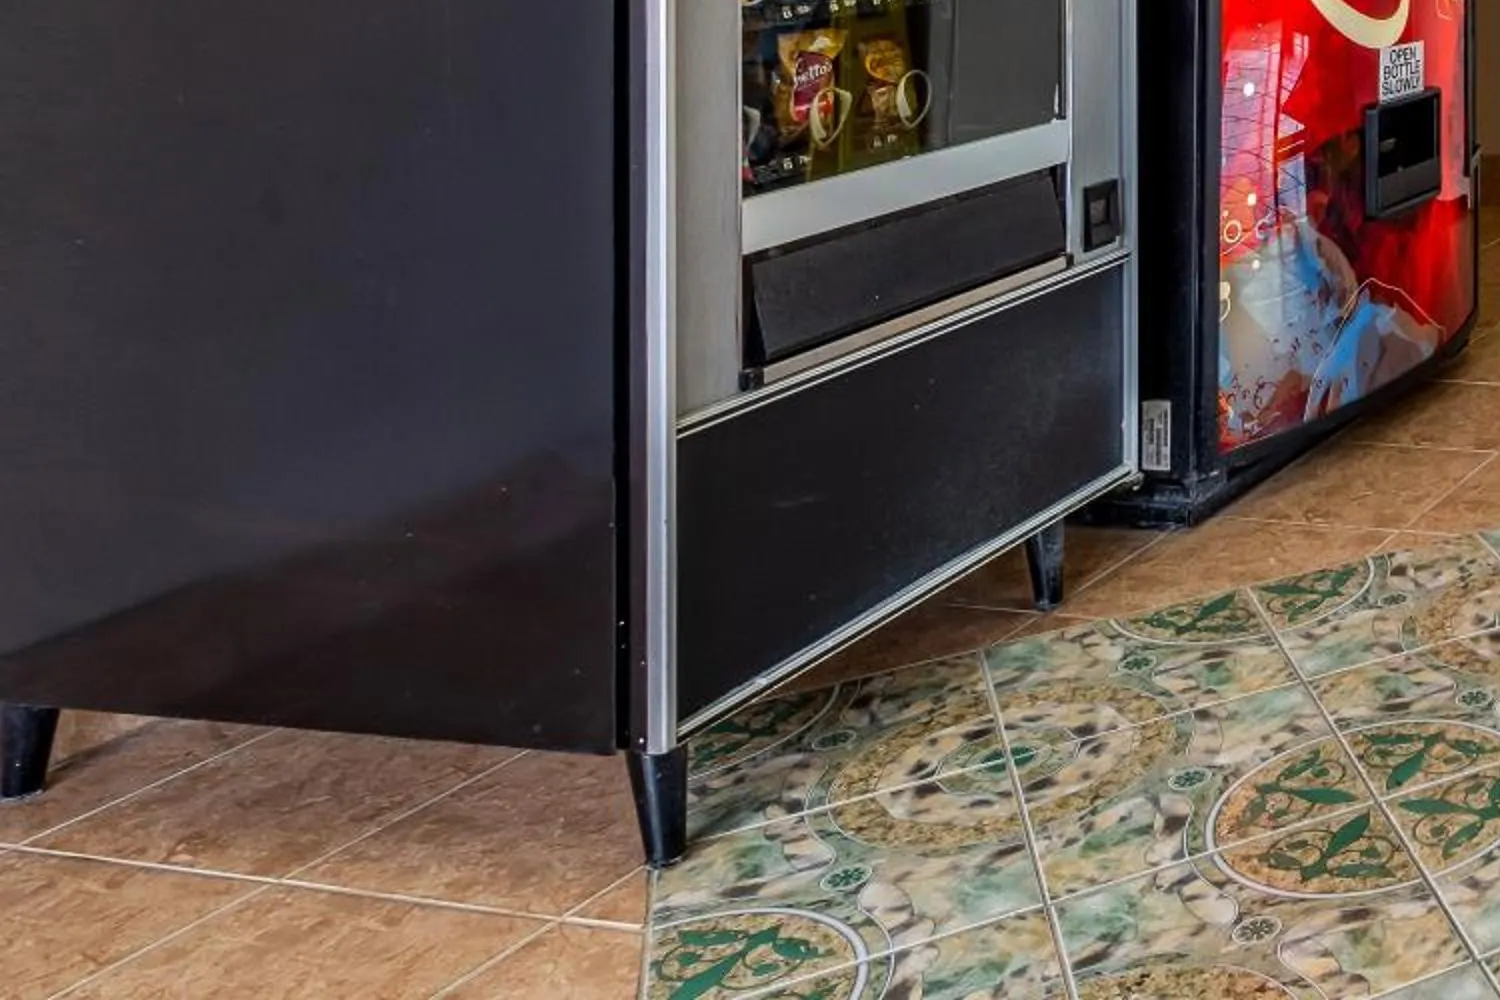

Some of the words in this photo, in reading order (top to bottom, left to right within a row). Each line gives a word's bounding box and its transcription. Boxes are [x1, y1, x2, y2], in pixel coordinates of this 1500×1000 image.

[1390, 46, 1417, 64] OPEN
[1383, 60, 1420, 80] BOTTLE
[1381, 77, 1419, 96] SLOWLY
